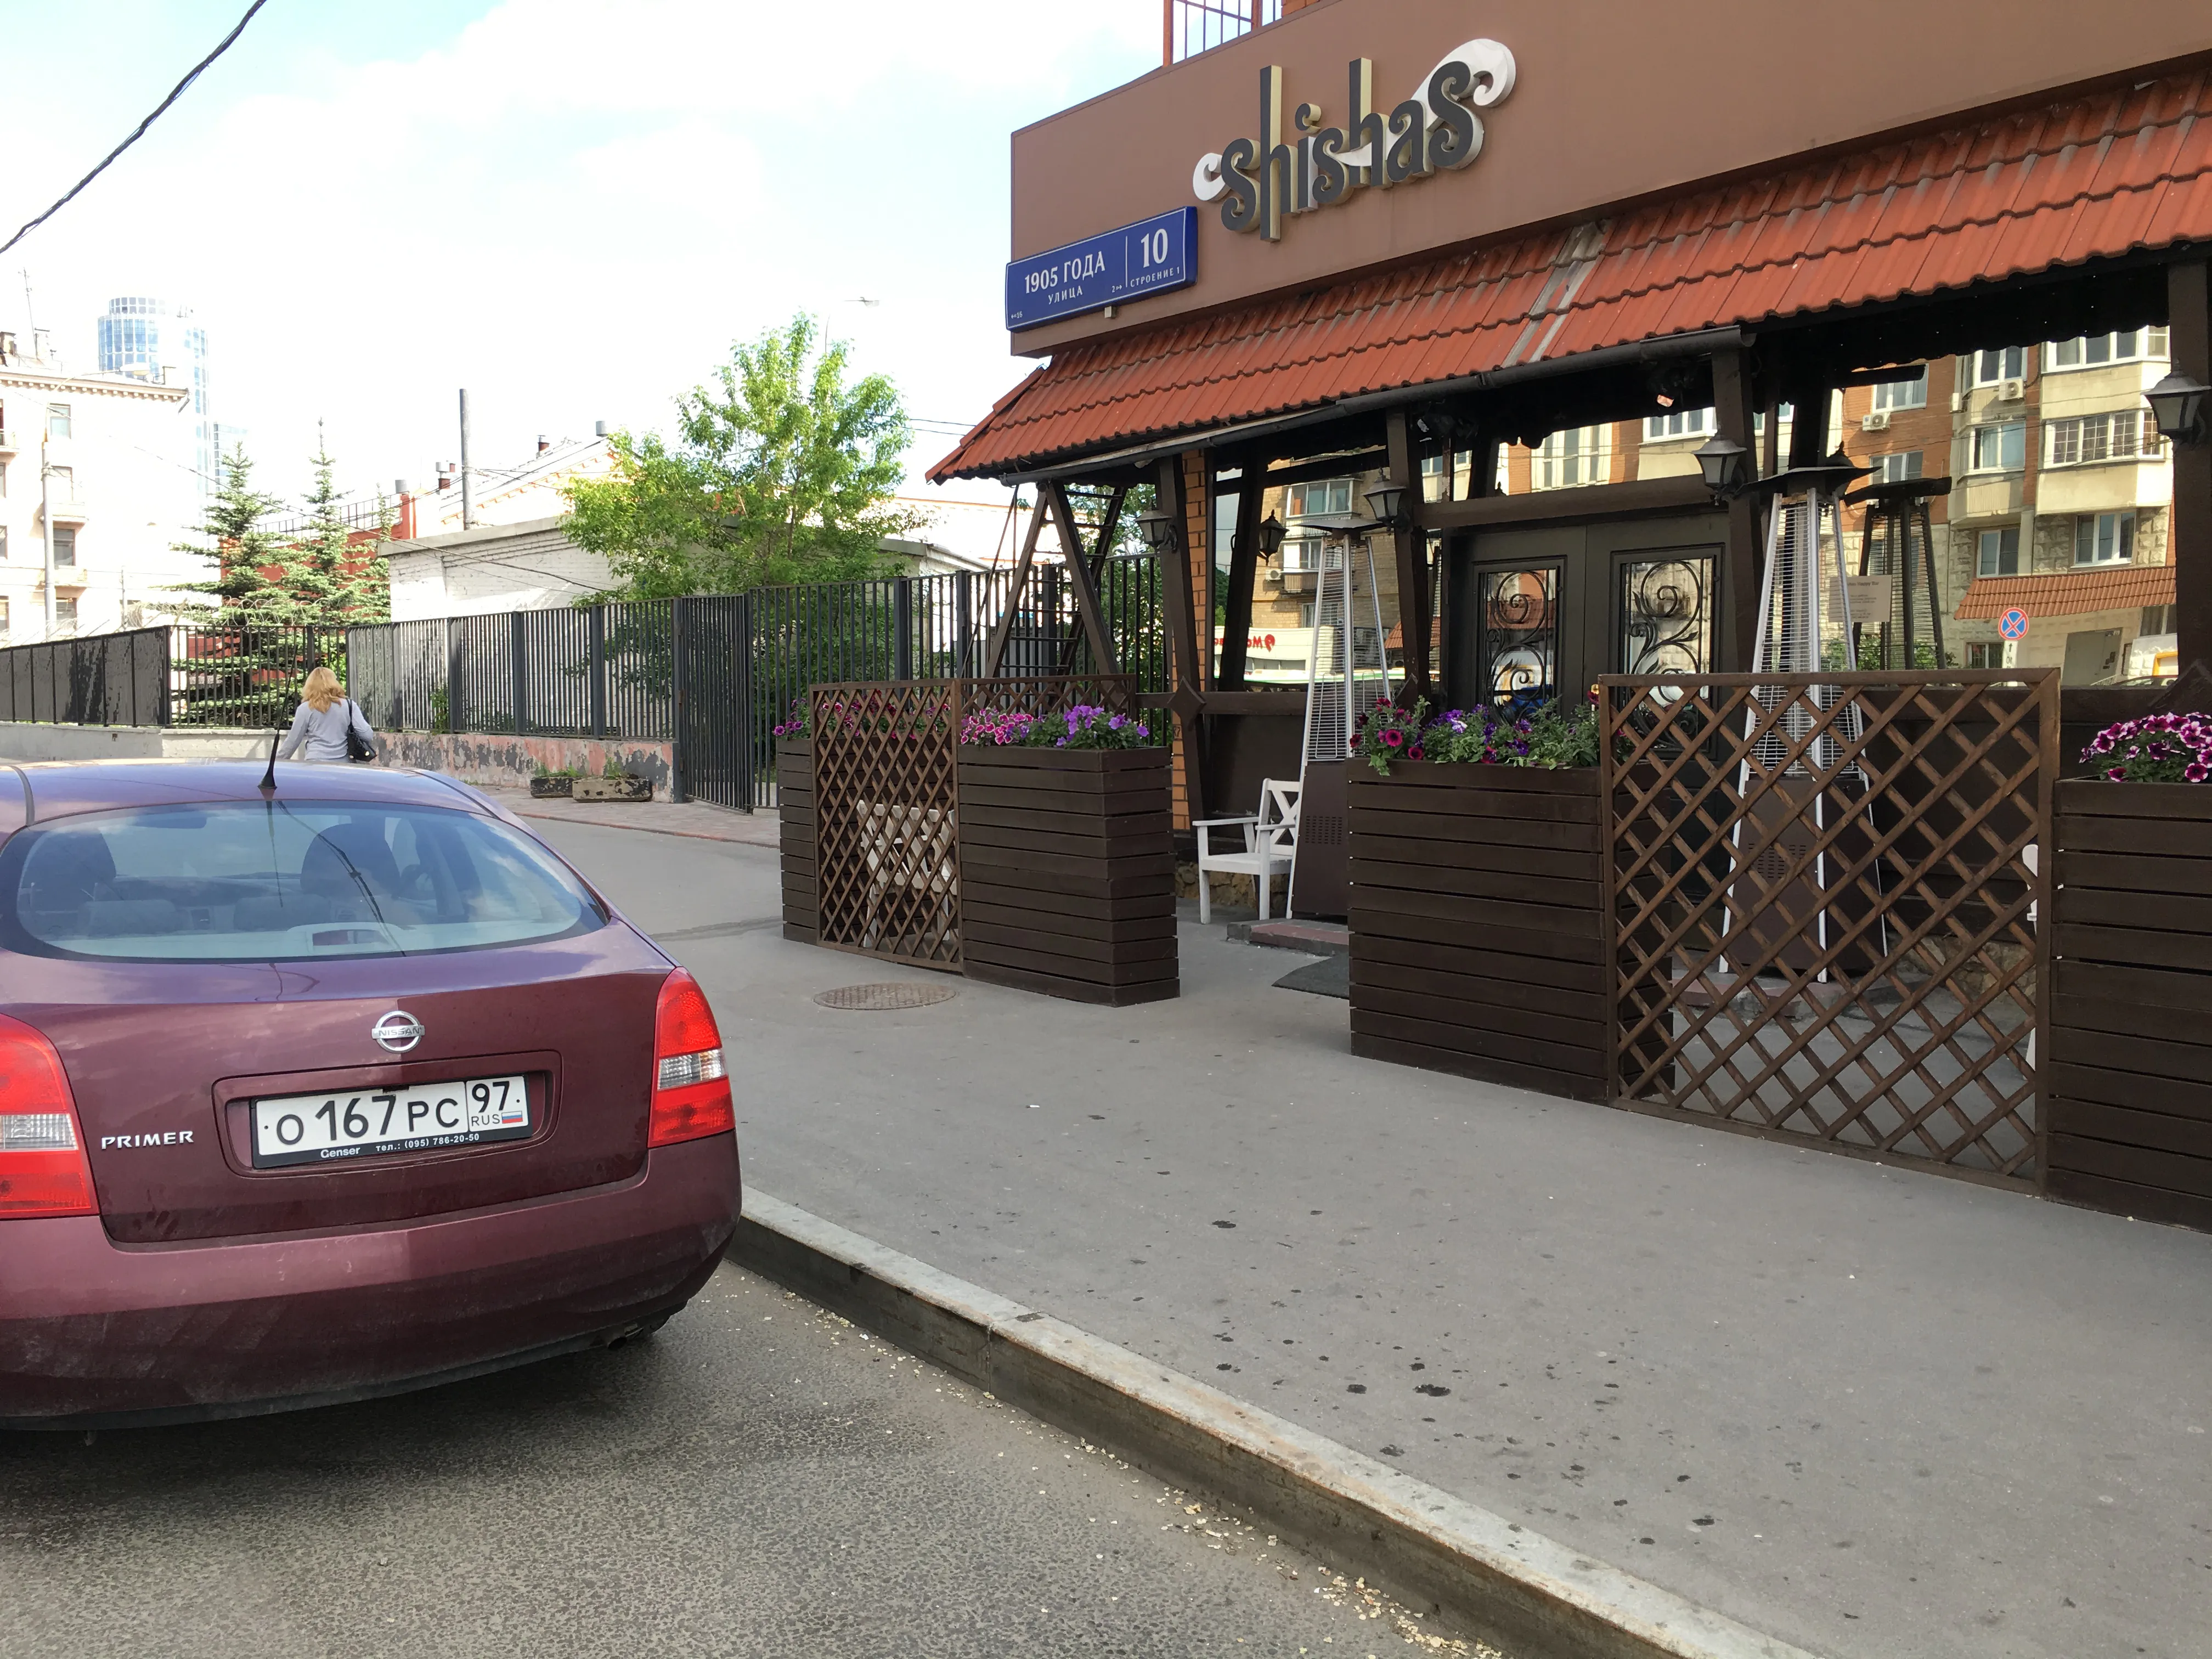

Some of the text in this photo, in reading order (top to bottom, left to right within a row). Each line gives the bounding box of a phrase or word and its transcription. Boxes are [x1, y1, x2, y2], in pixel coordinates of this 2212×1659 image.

[1141, 228, 1168, 268] 10
[1024, 251, 1105, 294] 1905 ГОДА
[1130, 268, 1174, 287] СТРОЕНИЕ
[1048, 285, 1082, 304] УЛИЦА
[379, 1027, 420, 1036] NISSAN
[472, 1081, 510, 1113] 97
[471, 1114, 500, 1126] RUS
[101, 1131, 194, 1149] PRIMER
[376, 1133, 479, 1152] тел.: (095) 786-20-50
[320, 1147, 361, 1158] Genser
